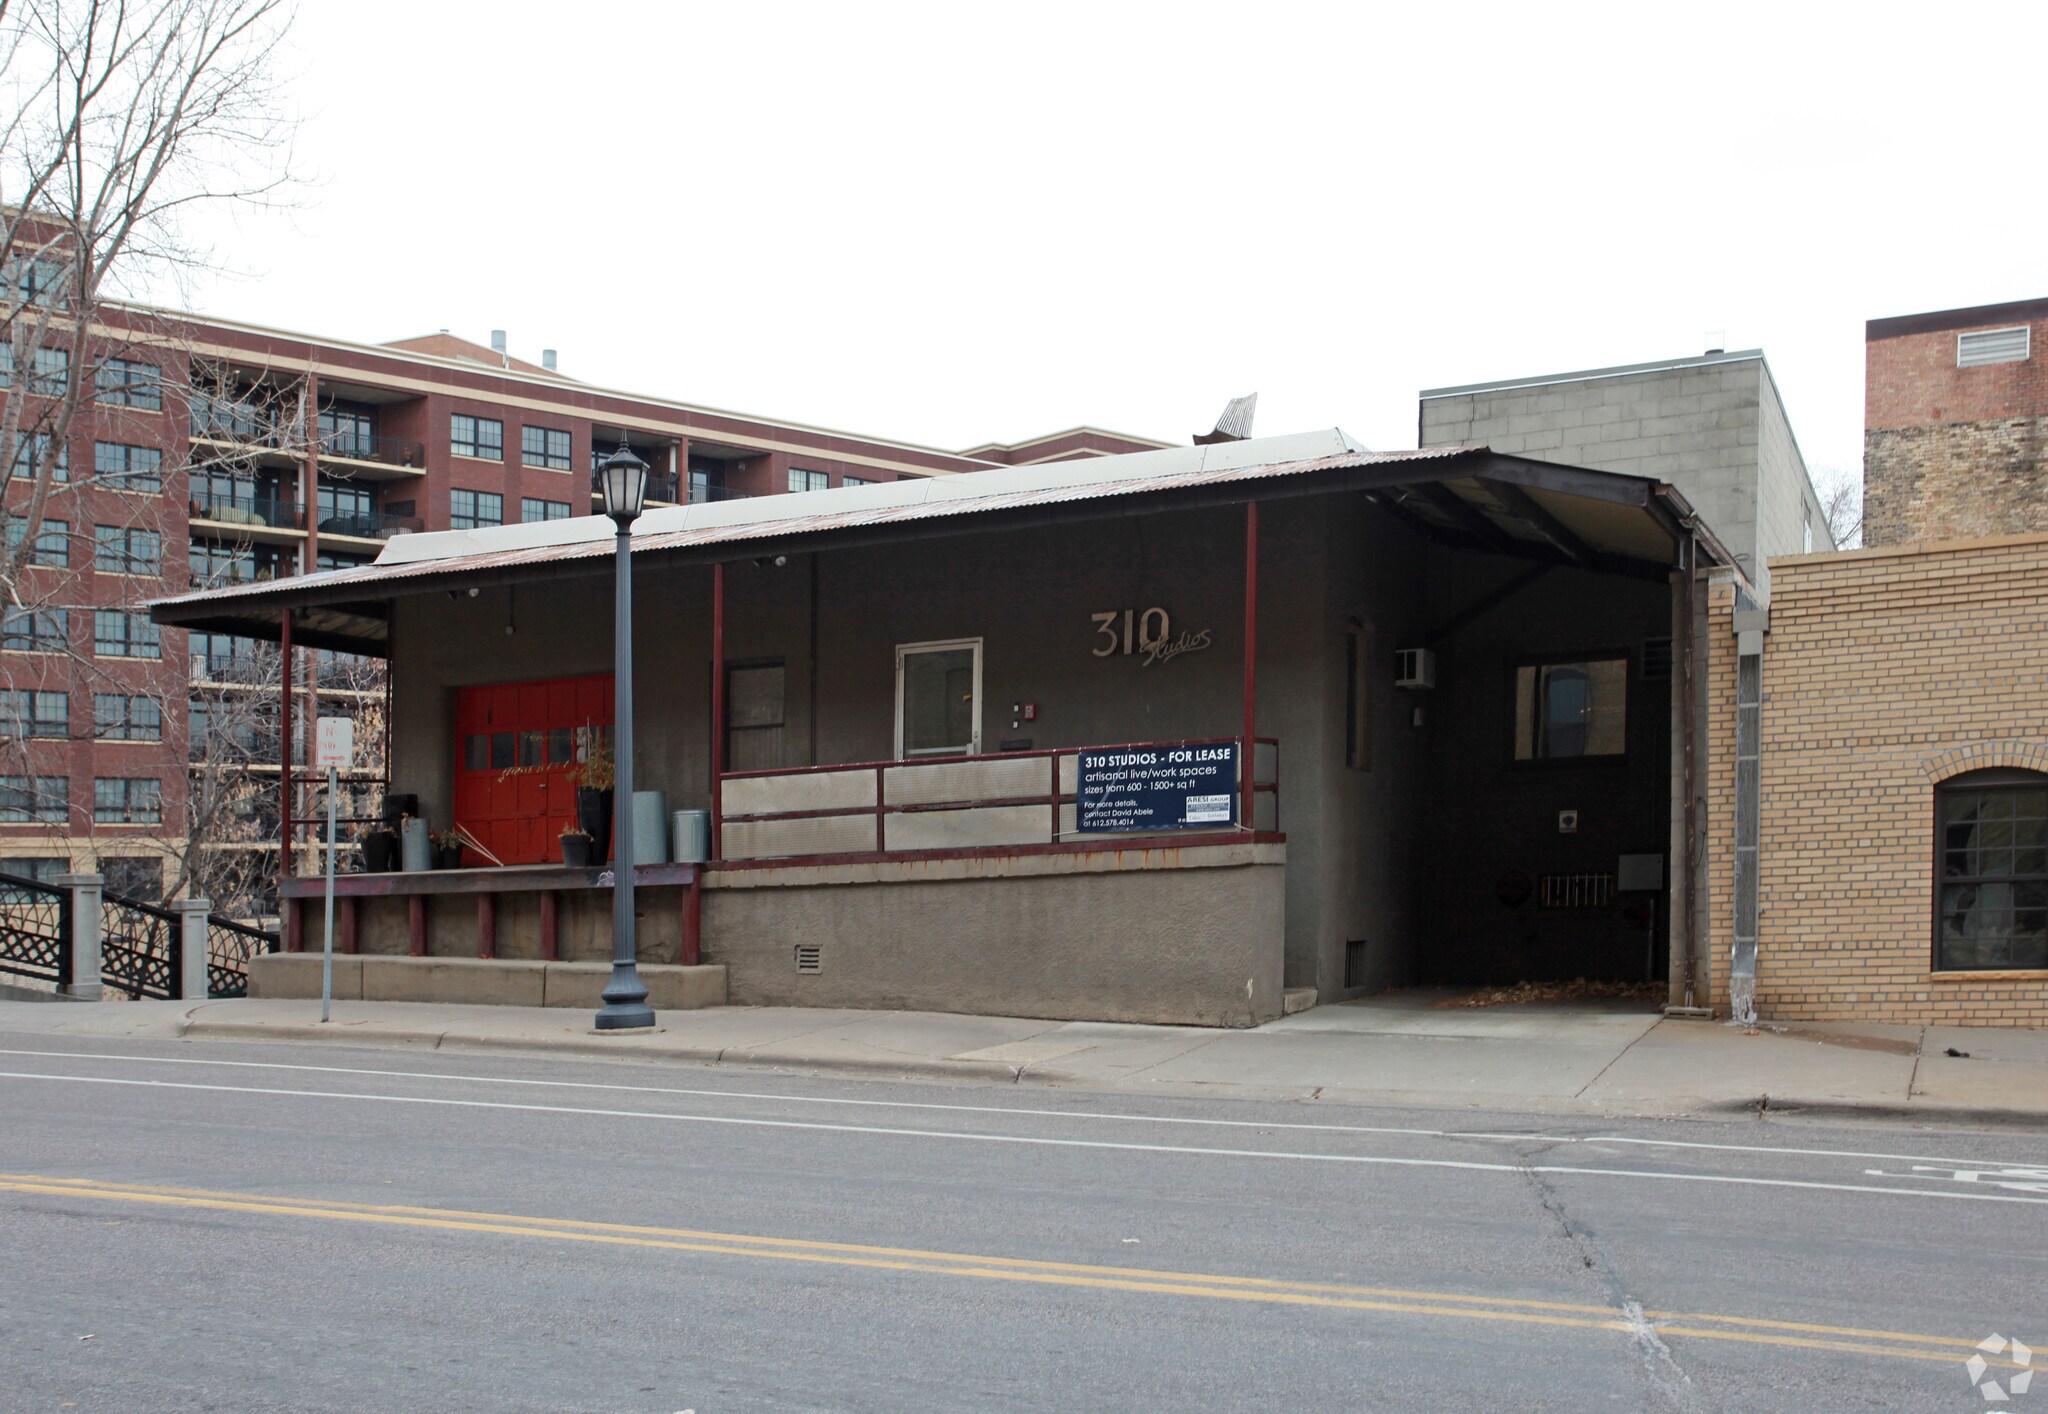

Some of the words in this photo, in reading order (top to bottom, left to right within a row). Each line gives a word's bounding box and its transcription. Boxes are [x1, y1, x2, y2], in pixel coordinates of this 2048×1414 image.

[1091, 607, 1170, 657] 310
[1085, 756, 1106, 768] 310
[1108, 753, 1157, 767] STUDIOS
[1168, 750, 1192, 763] FOR
[1195, 748, 1231, 761] LEASE
[1085, 769, 1128, 783] artisanal
[1130, 766, 1177, 779] live/work
[1179, 765, 1217, 778] spaces
[1084, 784, 1104, 795] sizes
[1105, 783, 1125, 793] from
[1127, 782, 1142, 792] 600
[1150, 780, 1175, 791] 1500+
[1177, 780, 1187, 791] sq
[1189, 779, 1196, 788] ft
[1084, 801, 1095, 809] For
[1096, 800, 1114, 808] more
[1084, 809, 1111, 818] contact
[1112, 808, 1132, 817] David
[1092, 818, 1134, 827] 612.578.4014
